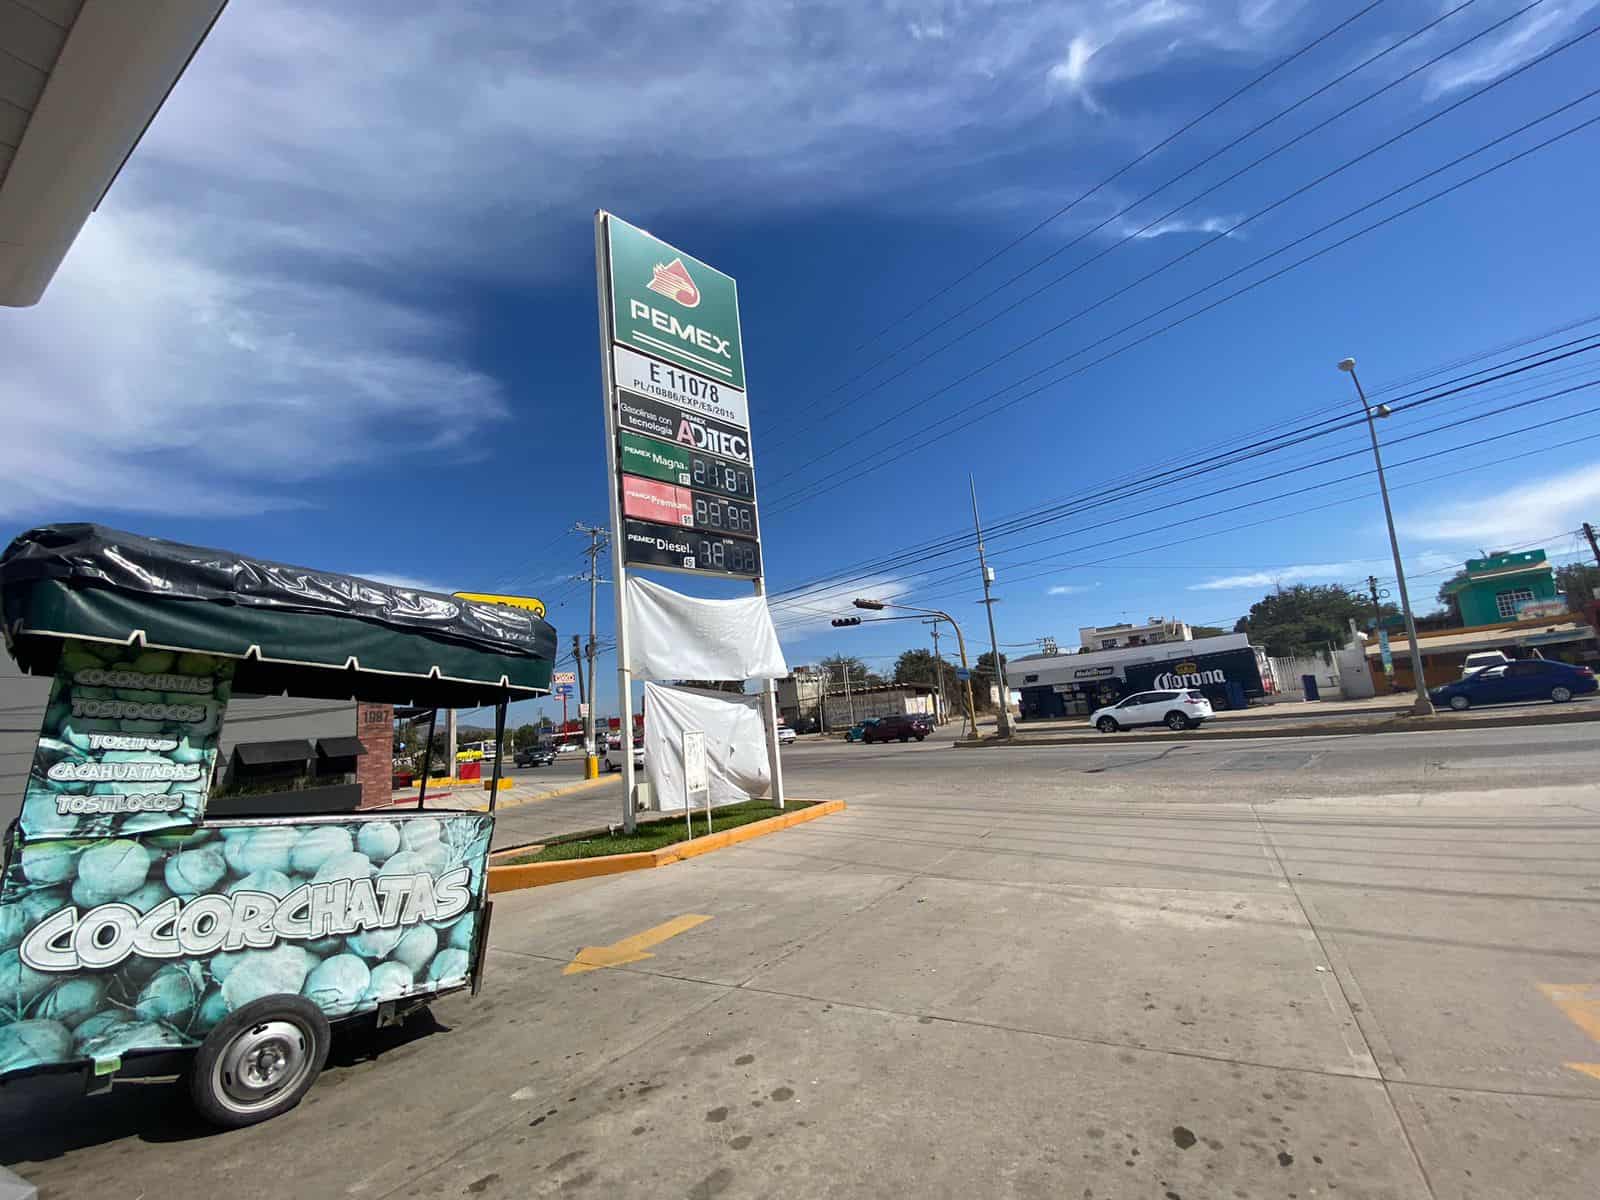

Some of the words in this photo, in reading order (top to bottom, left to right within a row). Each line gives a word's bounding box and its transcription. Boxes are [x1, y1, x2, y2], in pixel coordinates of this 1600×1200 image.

[630, 298, 732, 359] PEMEX
[650, 362, 660, 384] E
[667, 369, 719, 404] 11078
[659, 415, 673, 426] con
[624, 446, 651, 458] PEMEX
[652, 453, 686, 470] Magna
[651, 495, 689, 511] Premium
[627, 534, 656, 545] PEMEX
[656, 538, 690, 553] Diesel
[73, 669, 214, 694] COCORCHATAS
[1153, 668, 1227, 690] Corona
[71, 698, 207, 723] TOSTOCOCOS
[48, 762, 203, 782] CACAHUATADAS
[55, 793, 185, 815] TOSTILOCOS
[18, 867, 472, 972] COCORCHATAS
